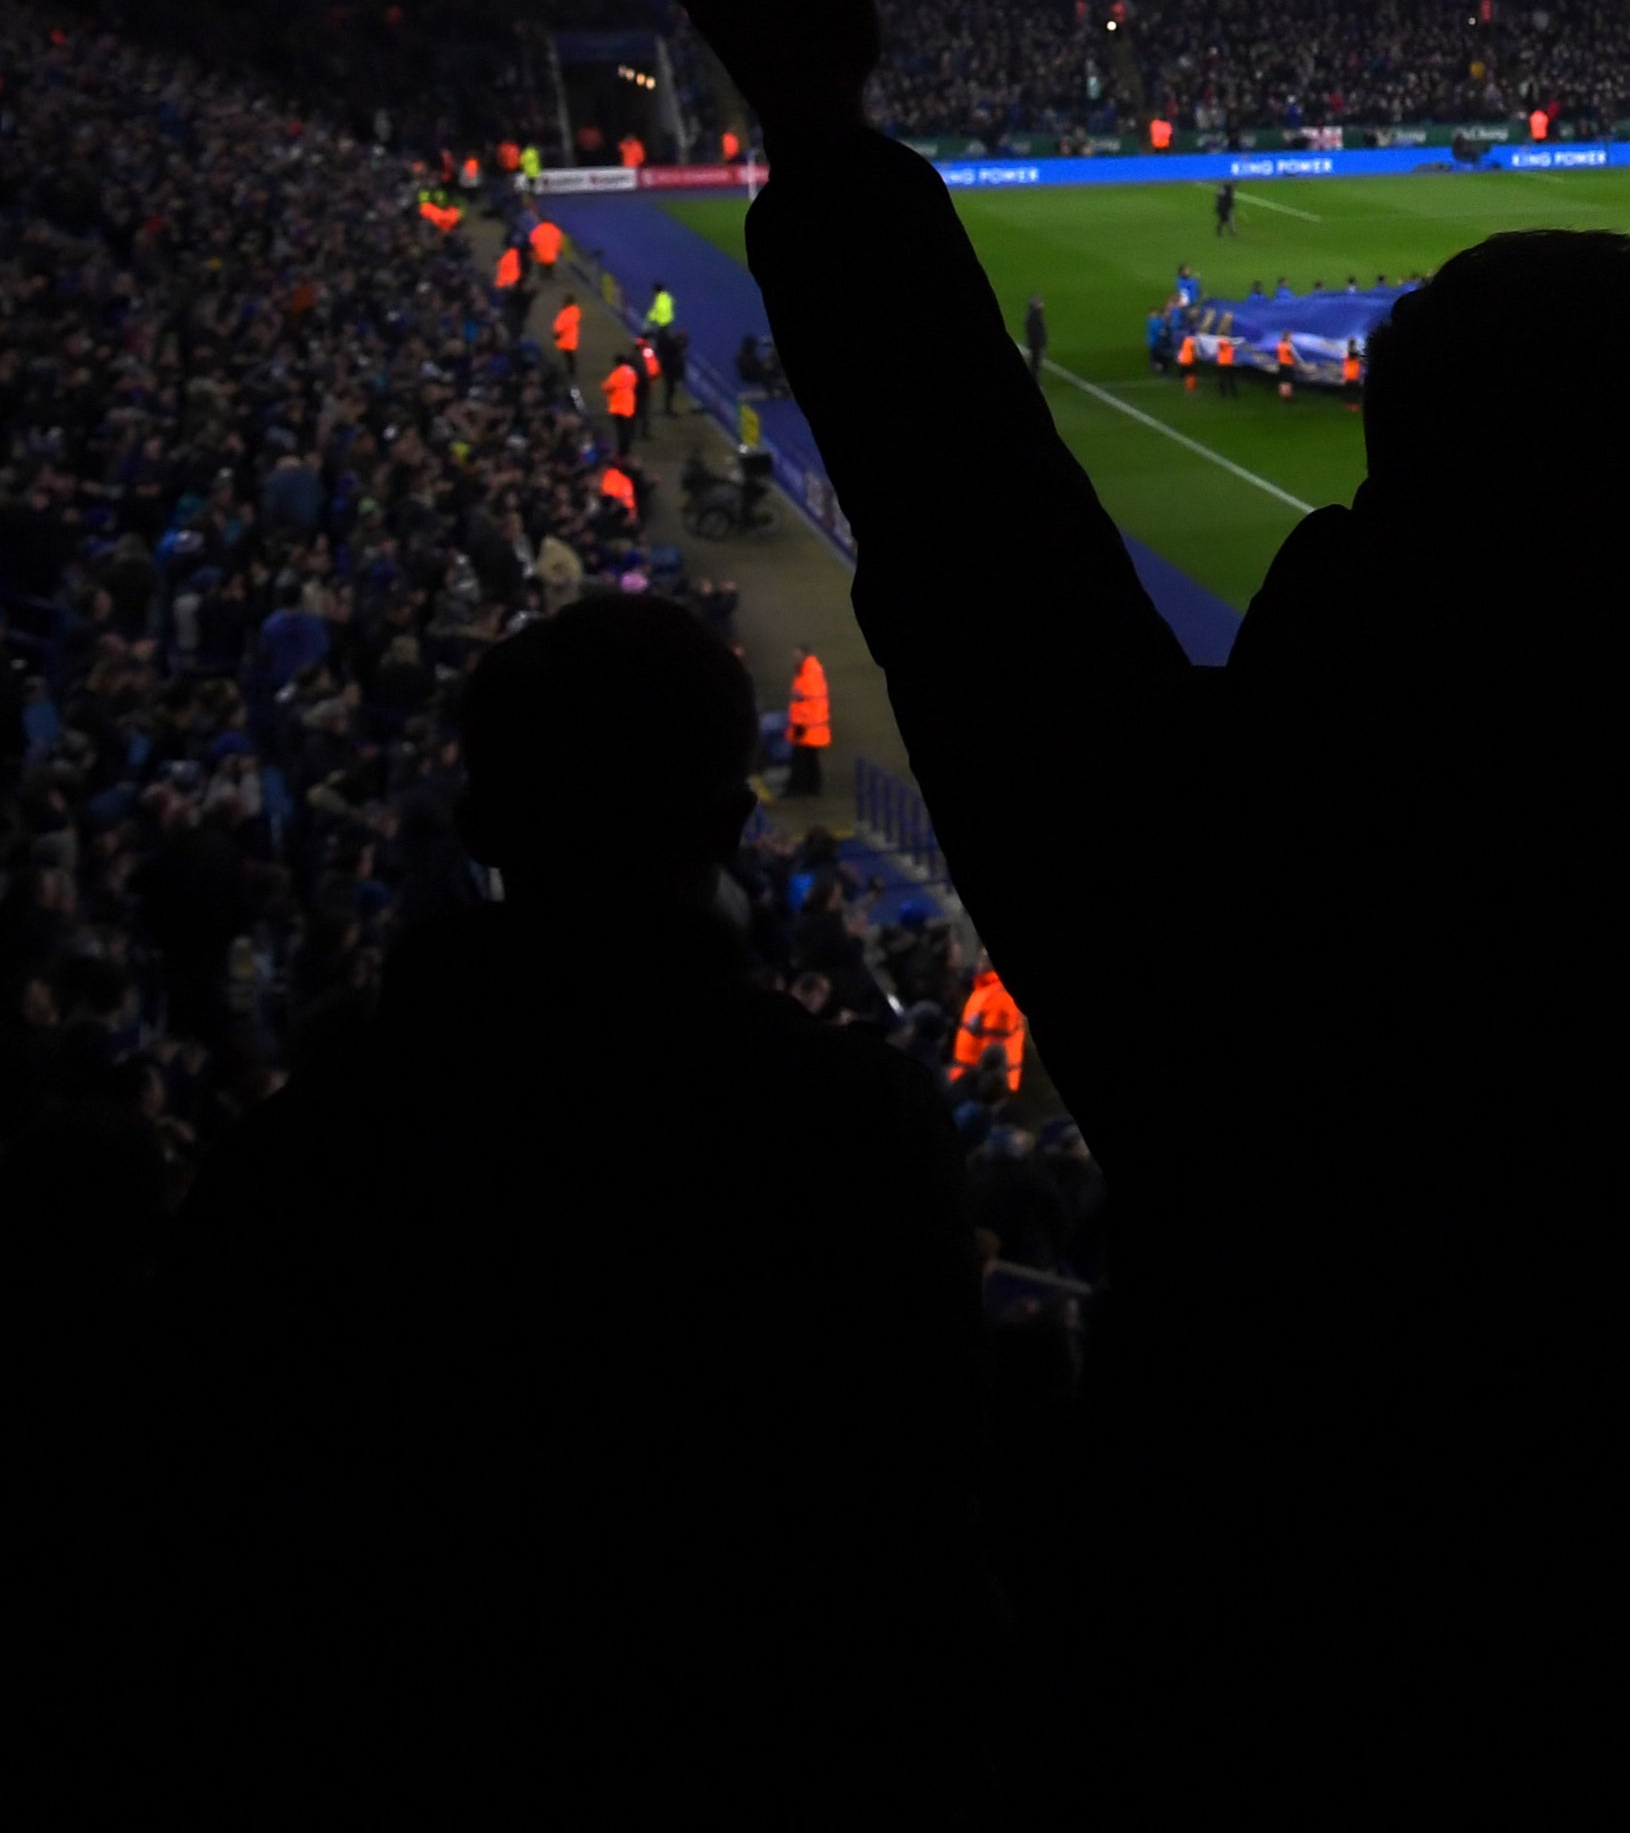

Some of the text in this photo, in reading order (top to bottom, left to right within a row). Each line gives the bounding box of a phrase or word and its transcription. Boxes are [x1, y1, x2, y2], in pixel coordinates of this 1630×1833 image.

[1231, 158, 1333, 176] KING POWER
[1512, 150, 1606, 167] KING POWER
[979, 166, 1039, 184] POWER
